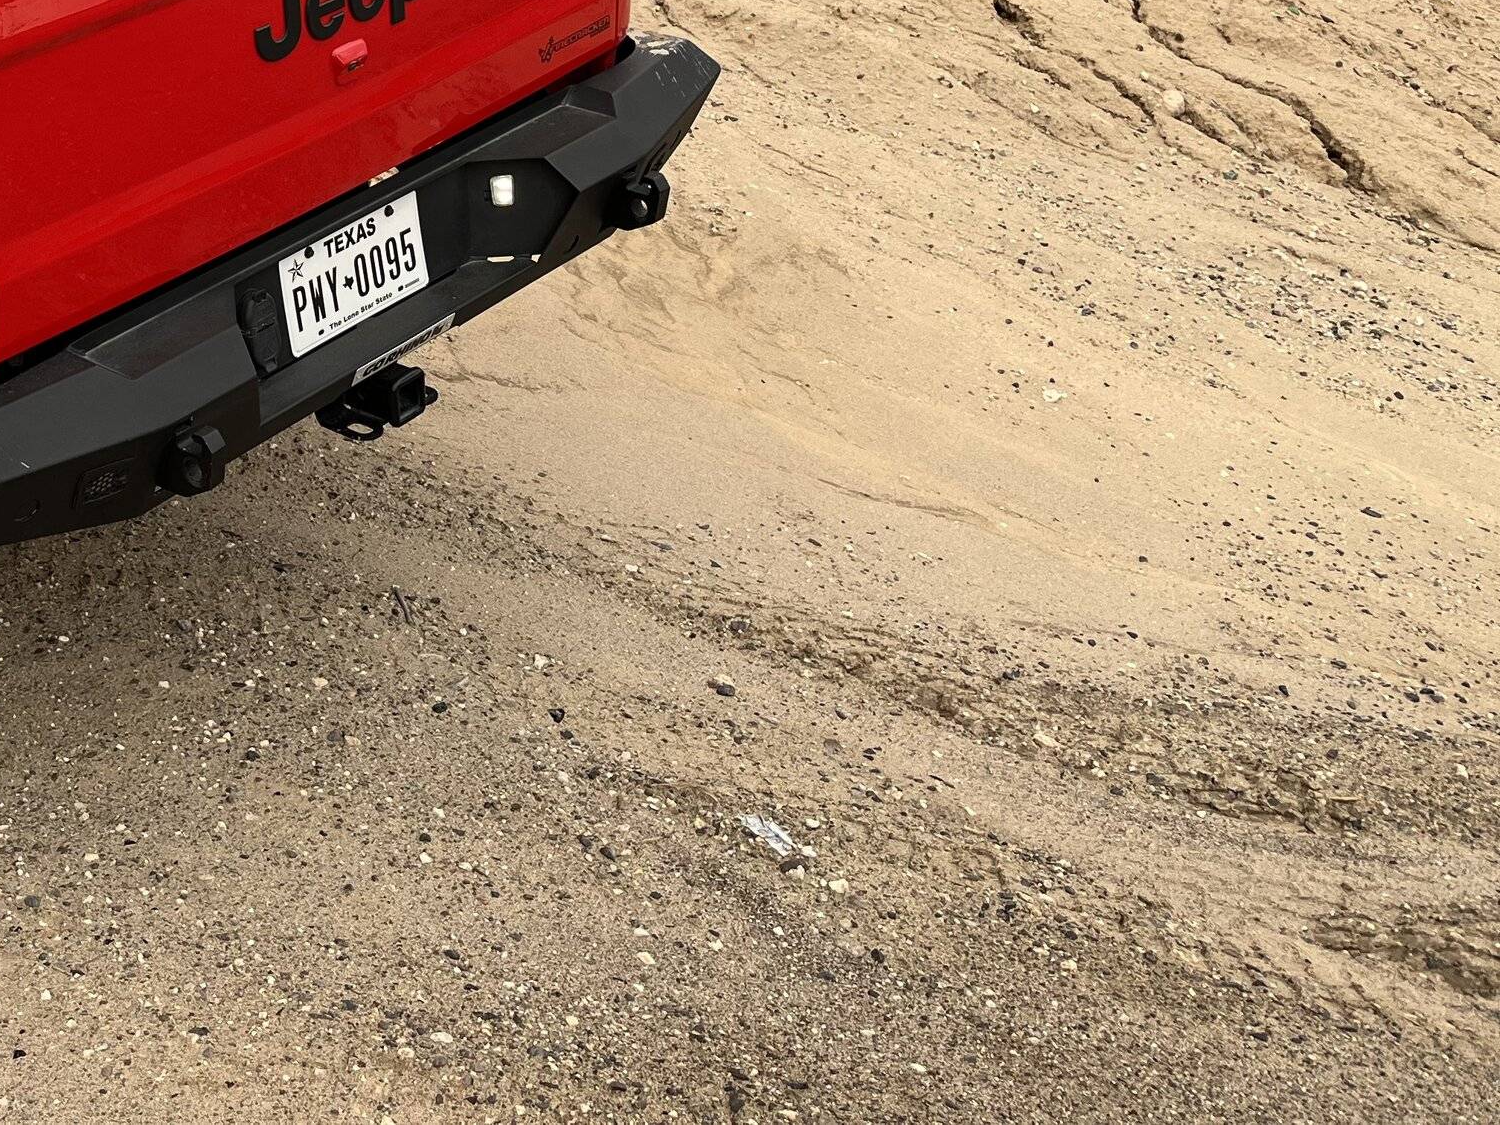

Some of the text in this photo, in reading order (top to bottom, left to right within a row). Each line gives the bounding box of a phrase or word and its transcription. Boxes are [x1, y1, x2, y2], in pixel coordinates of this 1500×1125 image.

[323, 217, 376, 258] TEXAS
[292, 227, 416, 333] PWY 0095
[329, 291, 393, 331] The Lone Star State
